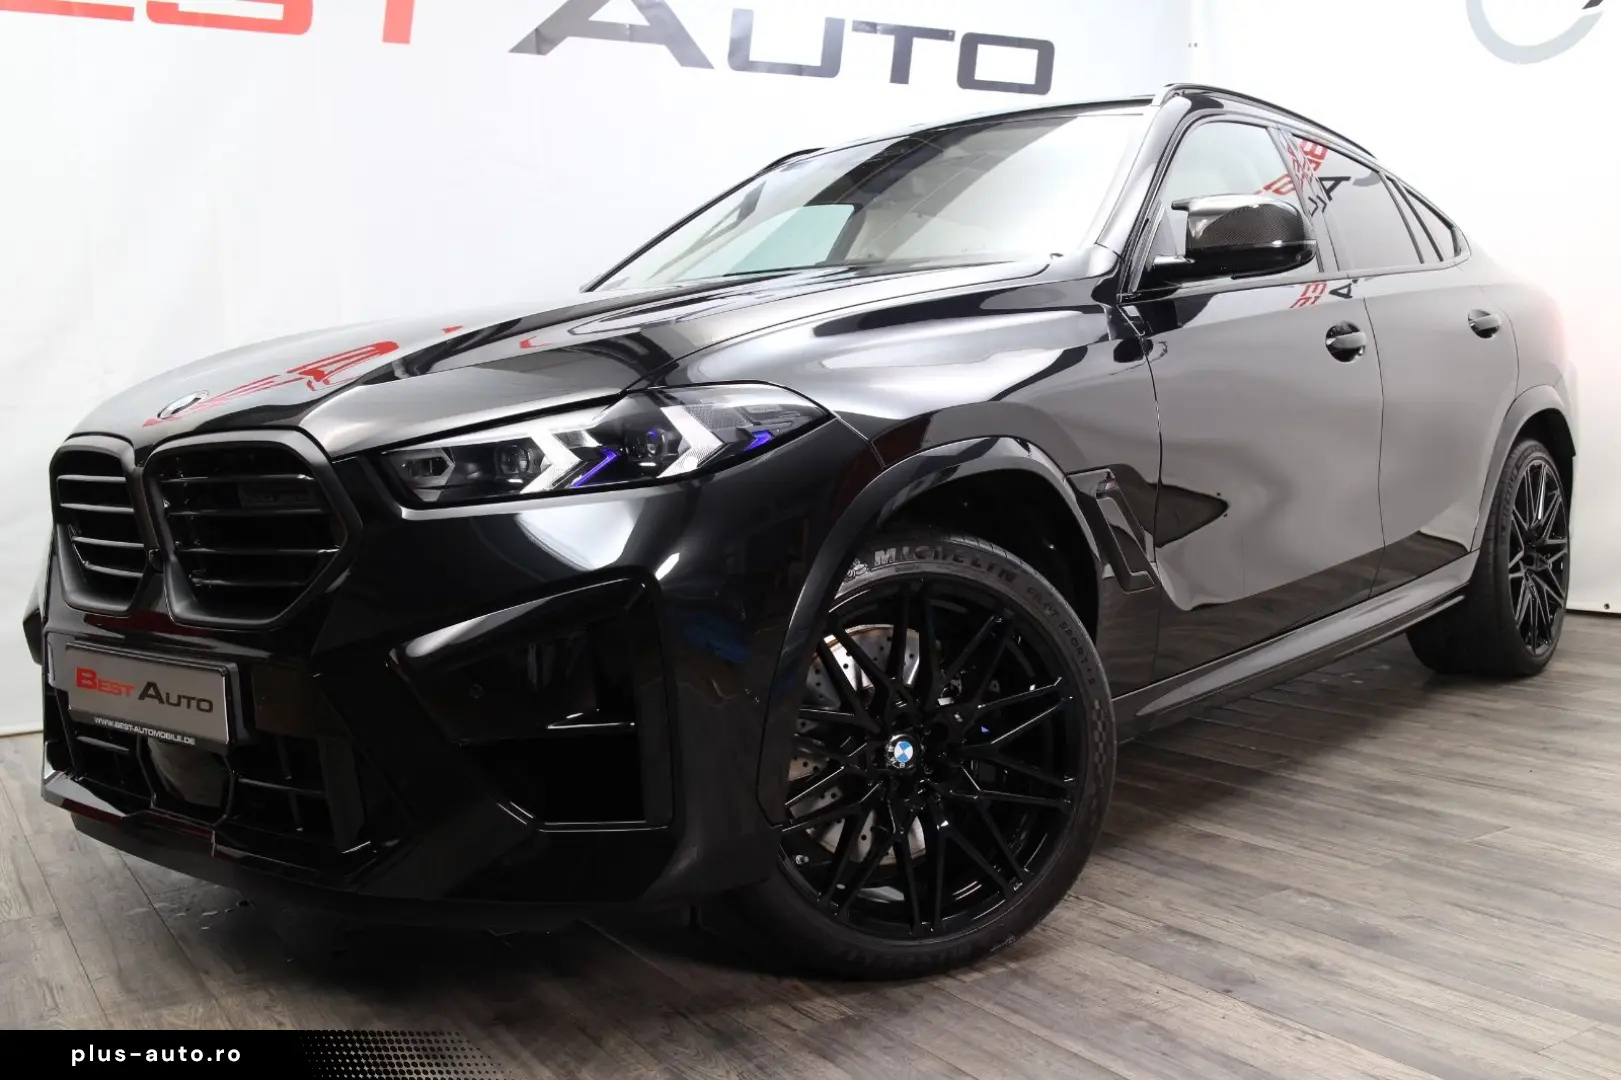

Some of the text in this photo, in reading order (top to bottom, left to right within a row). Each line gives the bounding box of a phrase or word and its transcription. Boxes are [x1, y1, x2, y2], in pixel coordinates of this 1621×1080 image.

[508, 0, 1056, 96] AUTO
[873, 545, 1017, 582] MICHELIN
[75, 667, 214, 713] BEST AUTO
